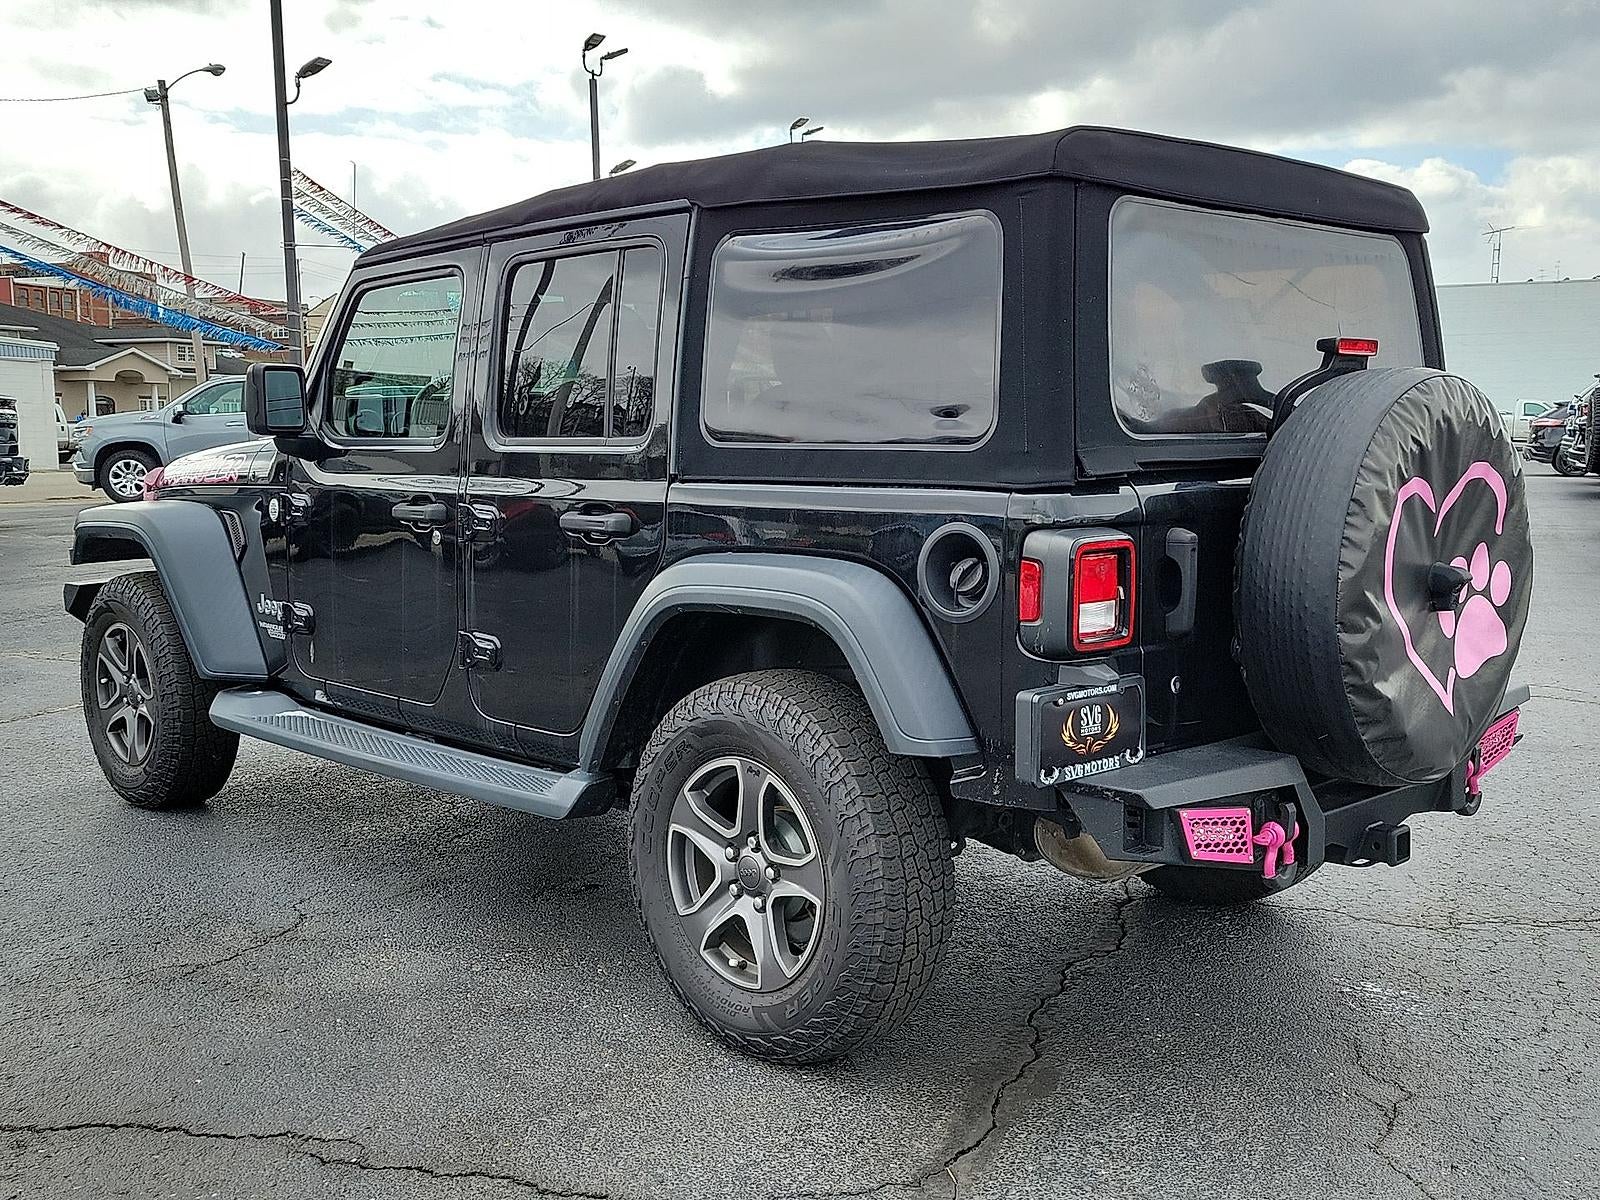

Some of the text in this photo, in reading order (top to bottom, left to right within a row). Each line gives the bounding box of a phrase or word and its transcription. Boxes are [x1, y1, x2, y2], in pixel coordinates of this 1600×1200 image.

[256, 593, 283, 621] Jeep
[1066, 684, 1118, 701] SVGMOTORS.COM
[1080, 704, 1102, 727] SVG
[1080, 726, 1102, 734] MOTORS
[641, 738, 693, 854] COOPER
